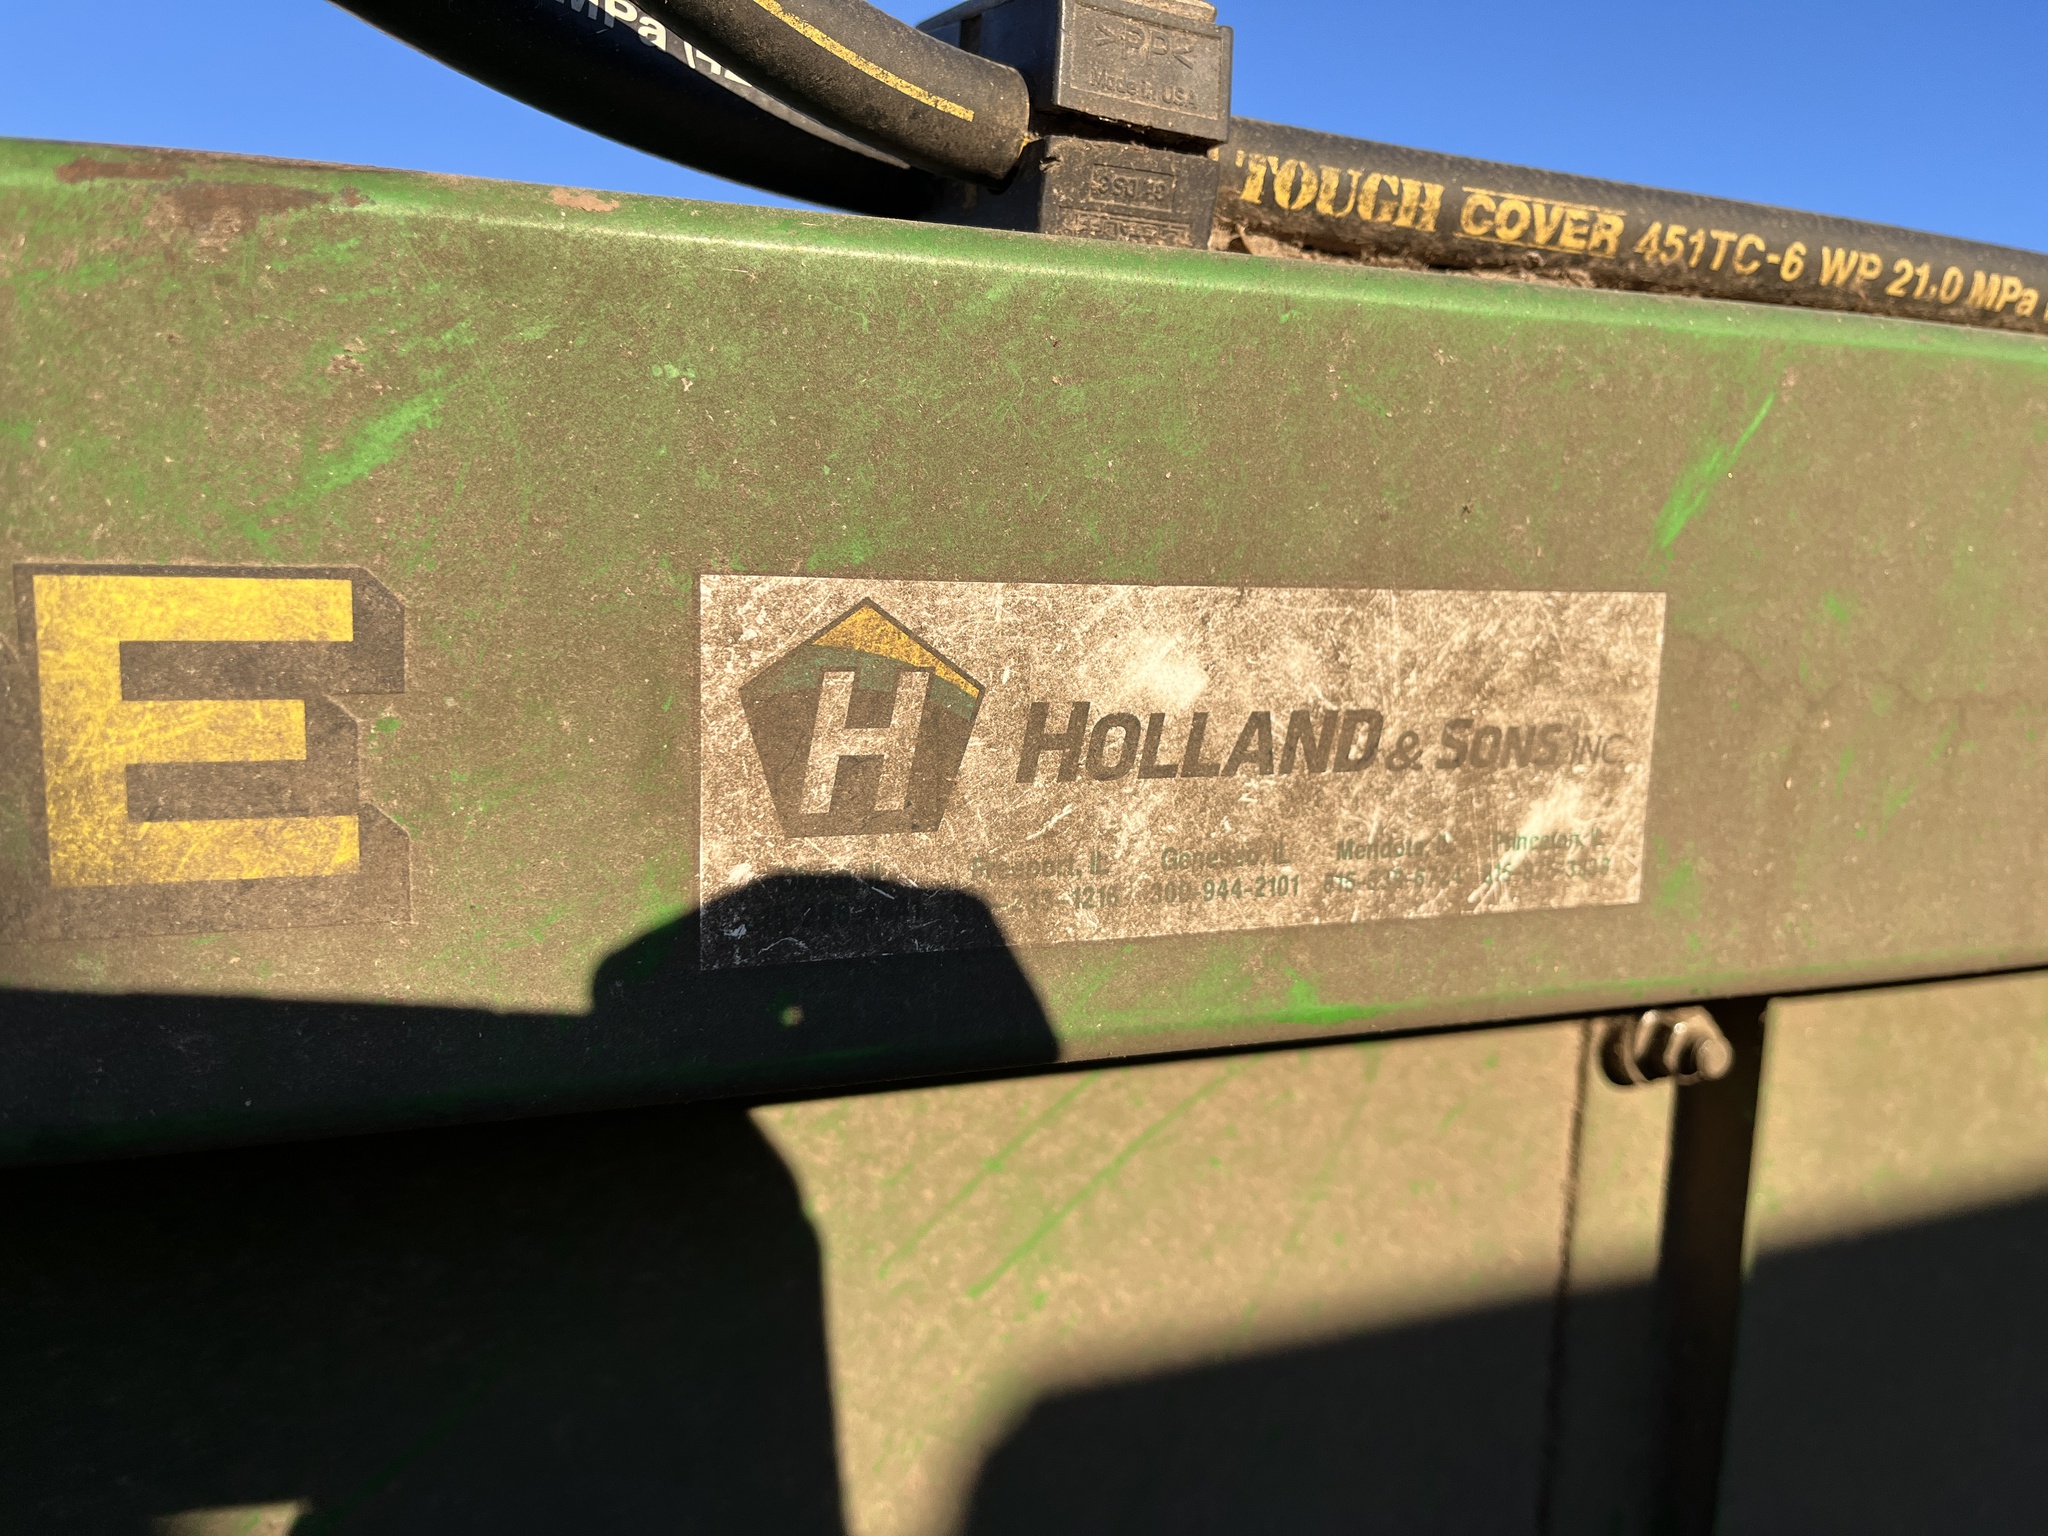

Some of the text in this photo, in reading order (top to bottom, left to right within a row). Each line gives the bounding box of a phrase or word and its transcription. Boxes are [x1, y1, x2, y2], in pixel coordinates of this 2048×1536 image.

[1236, 150, 1444, 232] TOUGH
[1460, 191, 1626, 258] COVER
[1633, 220, 1807, 282] 451TC-6
[1820, 246, 1883, 288] WP
[1885, 258, 1964, 305] 21.0
[1964, 269, 2039, 318] MPa
[33, 575, 360, 888] E
[1015, 701, 1383, 783] HOLLAND
[1385, 730, 1424, 772] &
[1435, 717, 1562, 770] SONS
